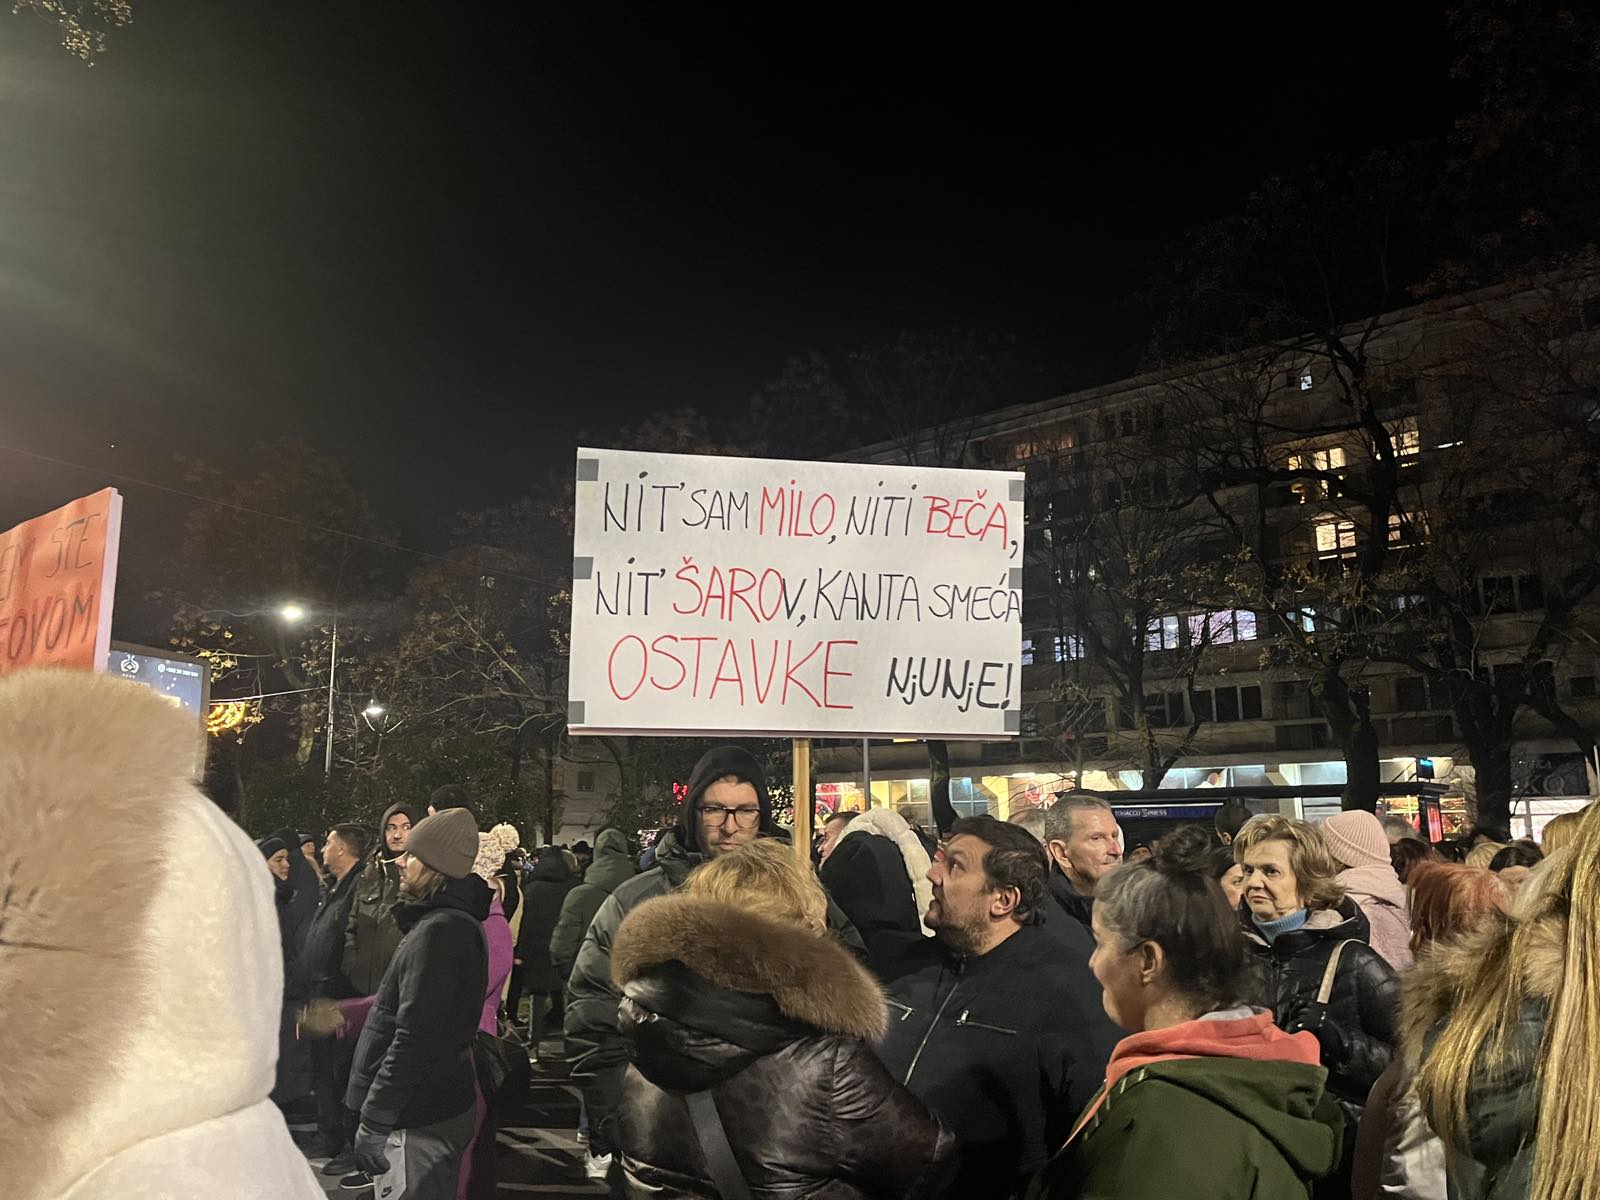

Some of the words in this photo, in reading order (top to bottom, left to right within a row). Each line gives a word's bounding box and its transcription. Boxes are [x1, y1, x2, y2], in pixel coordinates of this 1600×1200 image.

[681, 489, 750, 531] SAM
[923, 488, 1019, 559] BEČA,
[813, 568, 920, 622] KANTA
[928, 573, 1023, 623] SMEĆA
[608, 635, 859, 710] OSTAVKE
